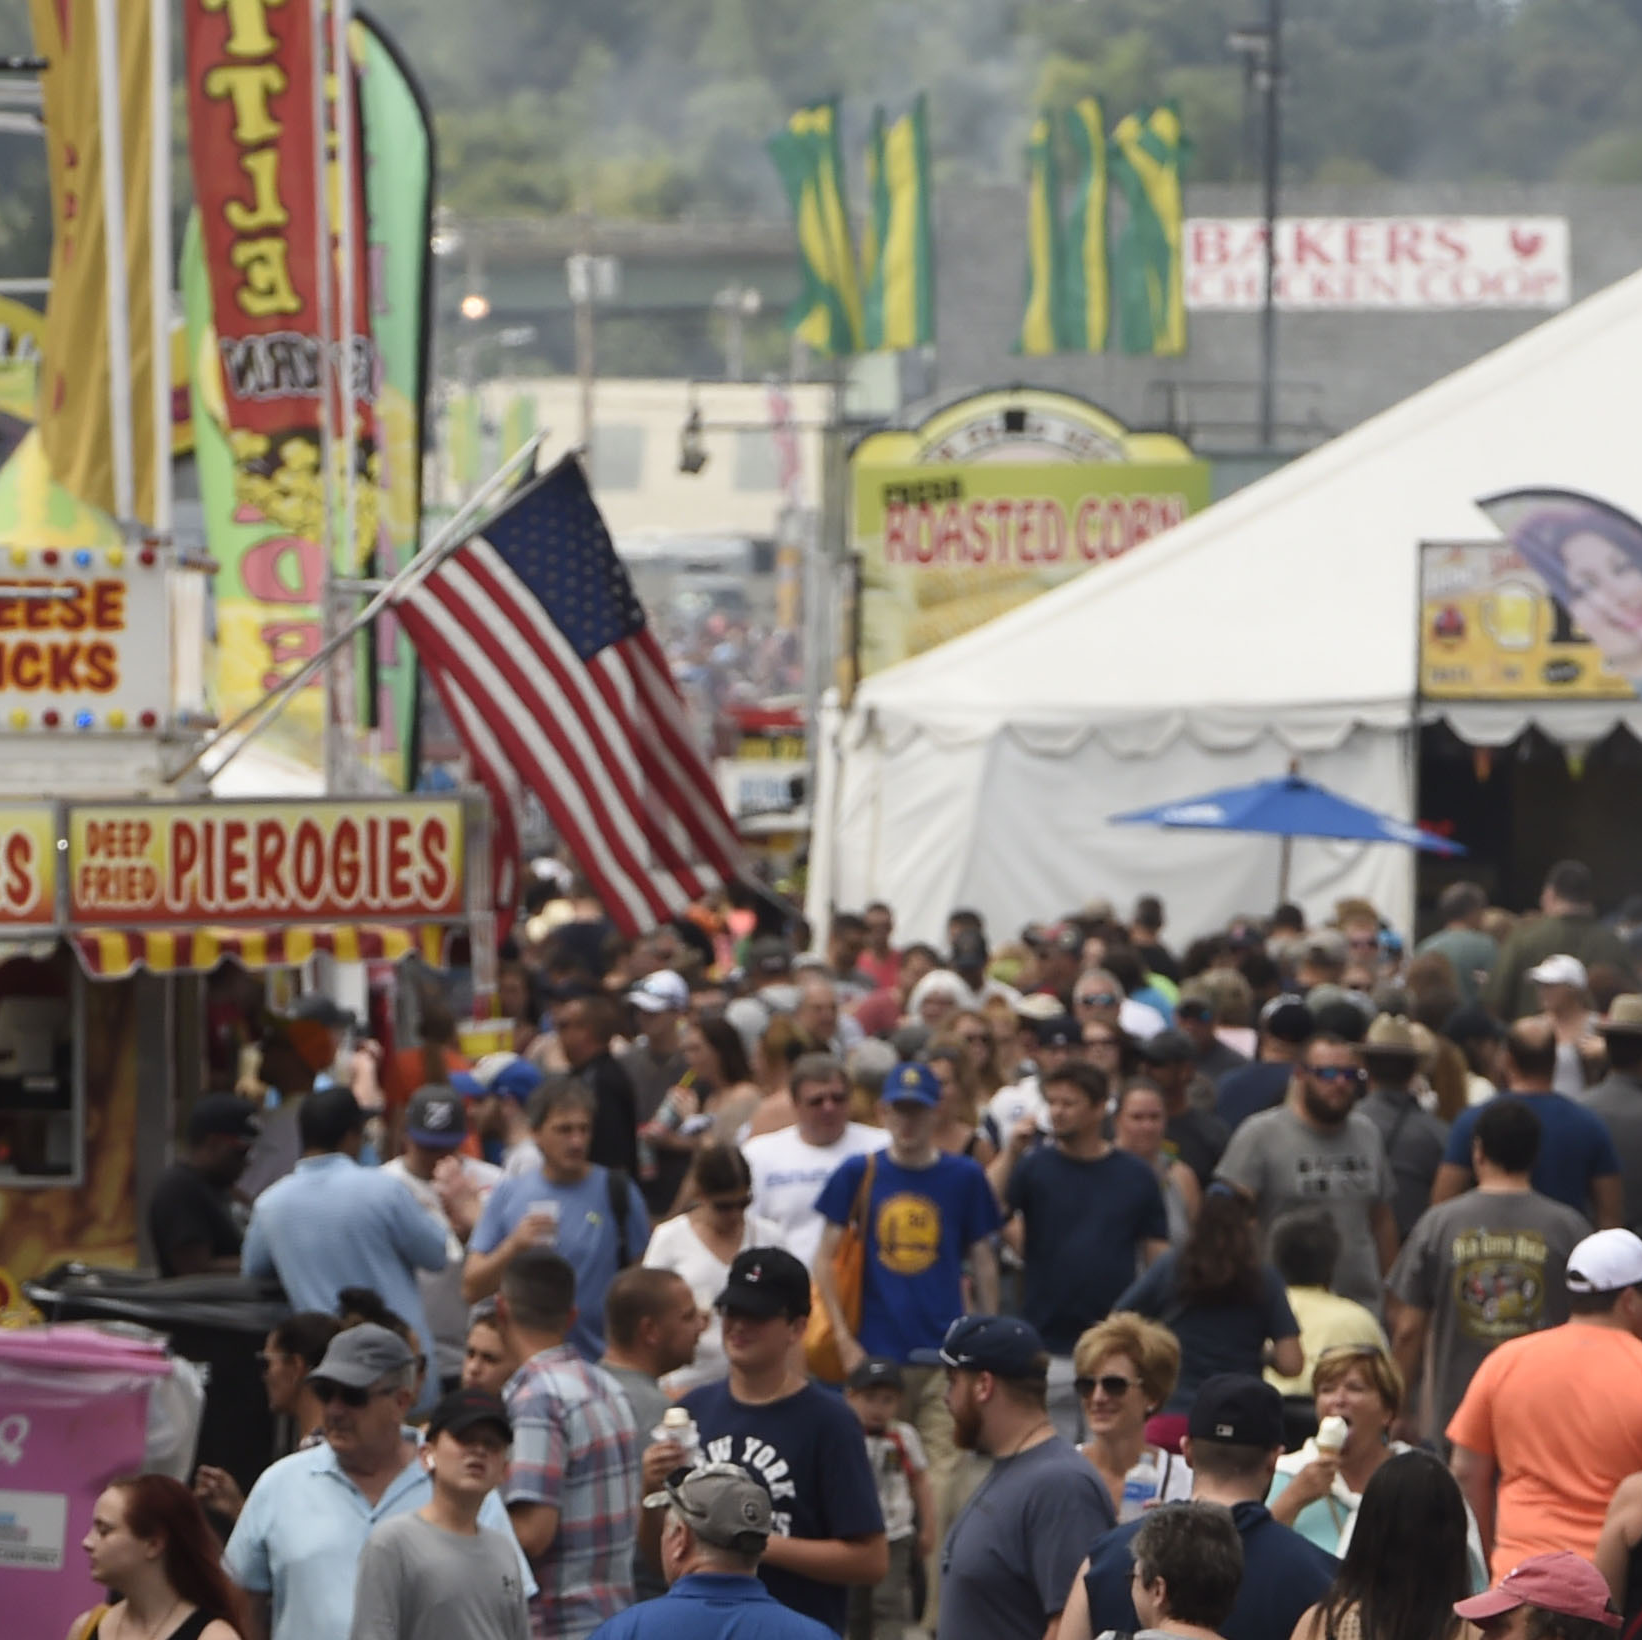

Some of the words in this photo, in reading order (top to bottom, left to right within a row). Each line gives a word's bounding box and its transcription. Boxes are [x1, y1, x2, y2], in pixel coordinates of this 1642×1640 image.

[1191, 224, 1470, 266] BAKERS
[1189, 270, 1397, 305] CHCKEN
[1415, 268, 1561, 307] COOP
[885, 497, 1067, 564] ROASTED
[77, 862, 159, 904] FRIED
[85, 817, 155, 859] DEEP
[167, 814, 451, 908] PIEROGIES
[741, 1435, 796, 1500] YORK
